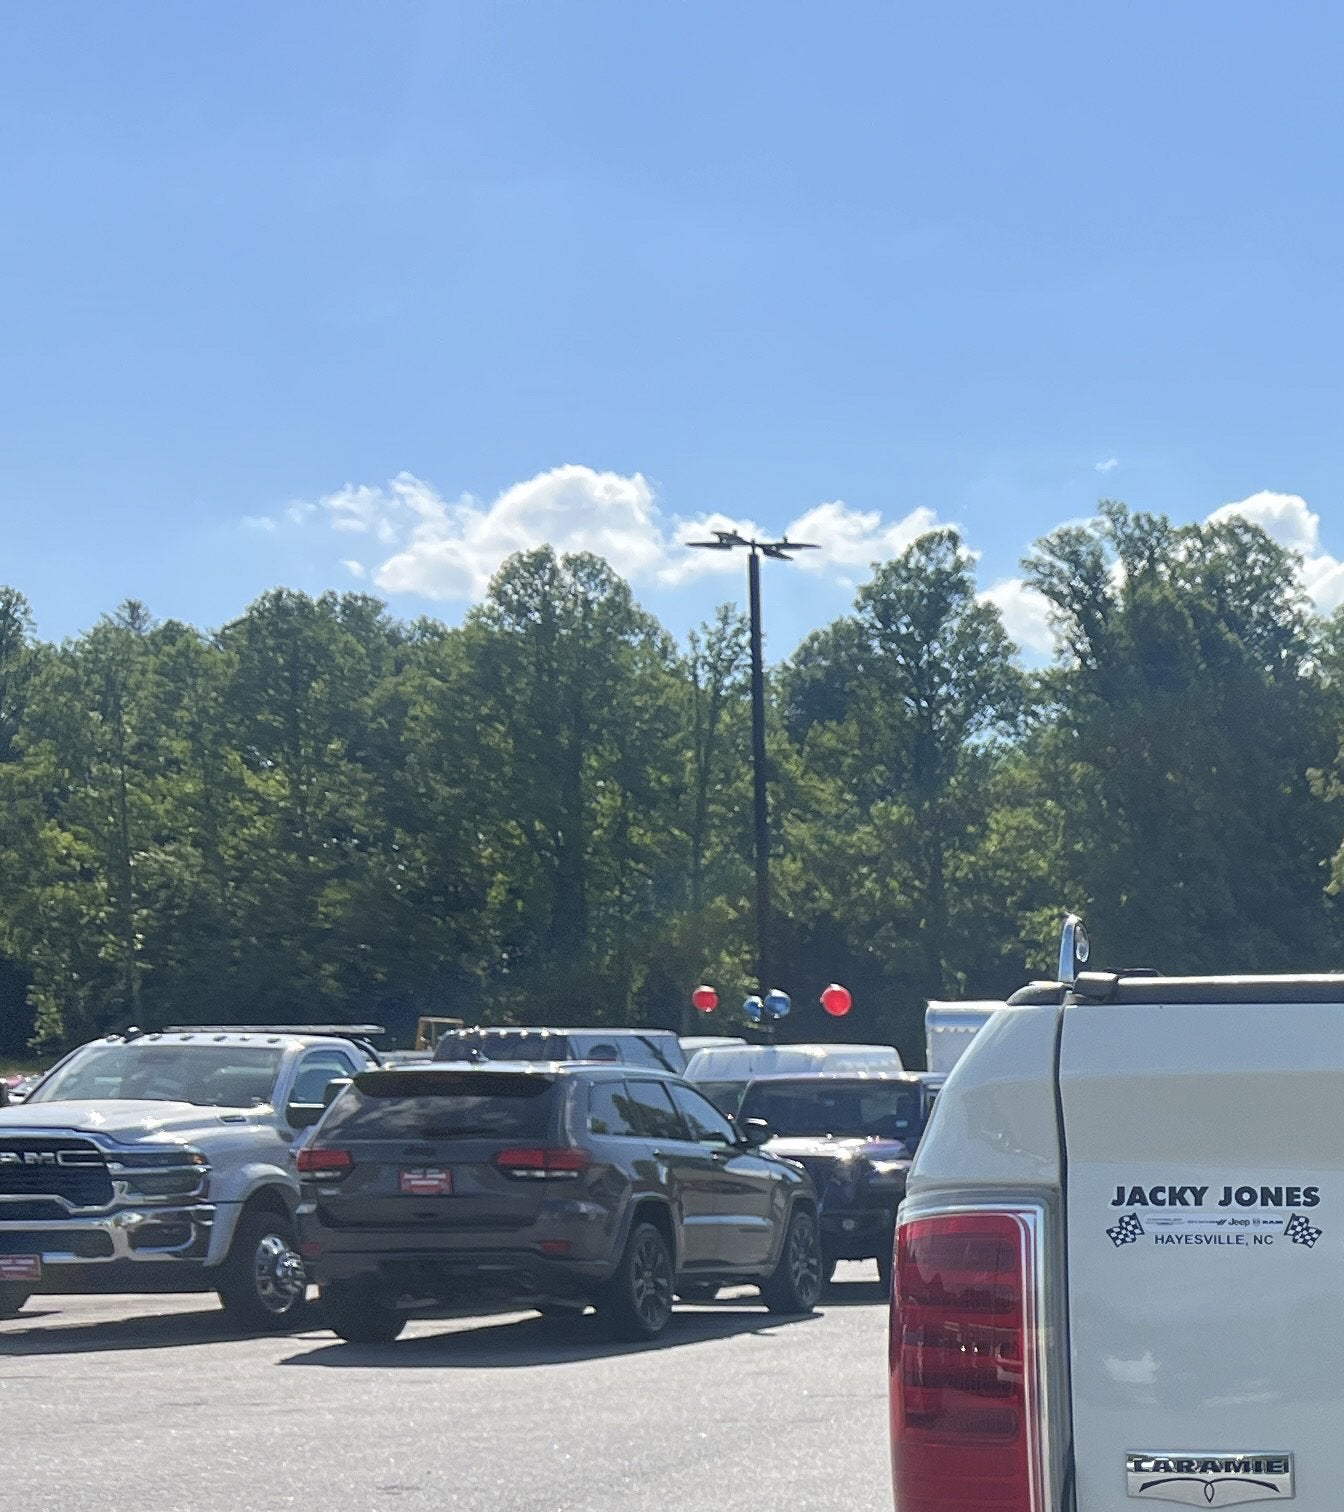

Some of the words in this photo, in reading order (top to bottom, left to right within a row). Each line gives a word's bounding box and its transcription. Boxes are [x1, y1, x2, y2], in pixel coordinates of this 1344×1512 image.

[0, 1151, 57, 1165] AM
[1110, 1185, 1209, 1207] JACKY
[1218, 1186, 1321, 1207] JONES
[1228, 1217, 1250, 1227] Jeep
[1154, 1234, 1249, 1246] HAYESVILLE,
[1253, 1234, 1274, 1245] NC
[1132, 1457, 1285, 1473] LARAMIE
